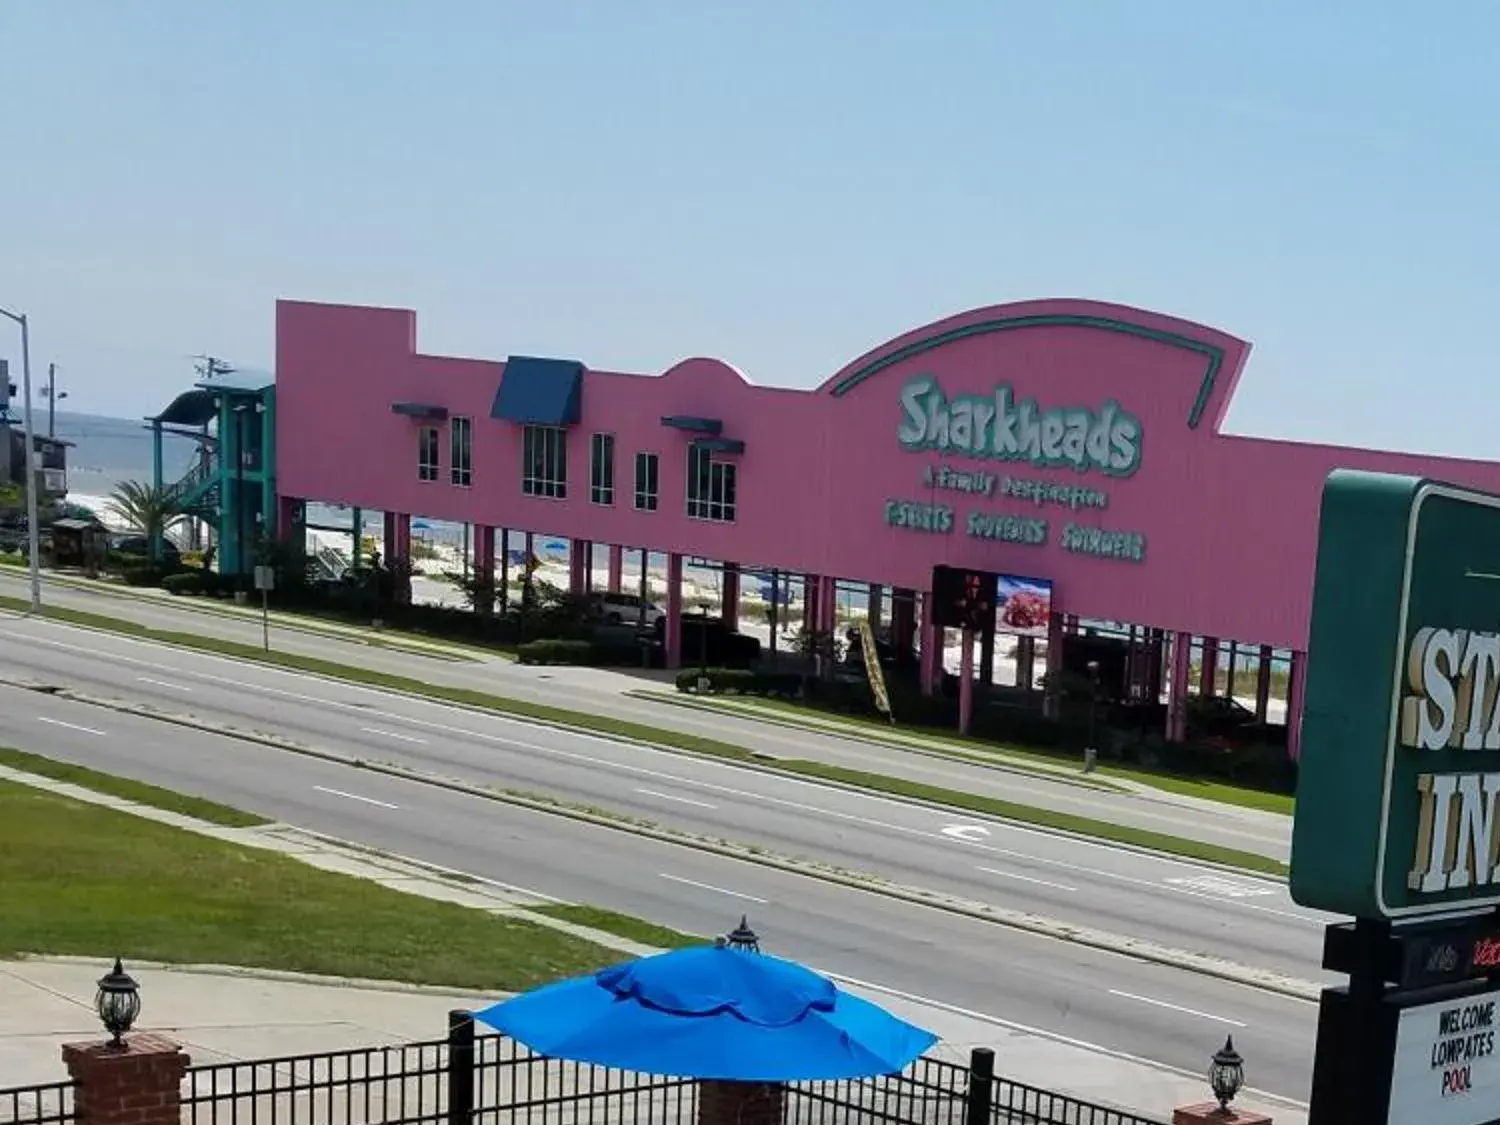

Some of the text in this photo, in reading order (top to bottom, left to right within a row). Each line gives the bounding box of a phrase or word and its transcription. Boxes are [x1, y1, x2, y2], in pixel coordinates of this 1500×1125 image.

[898, 374, 1141, 476] Sharkheads
[1439, 1001, 1495, 1036] WELCOME
[1441, 1064, 1472, 1096] POOL
